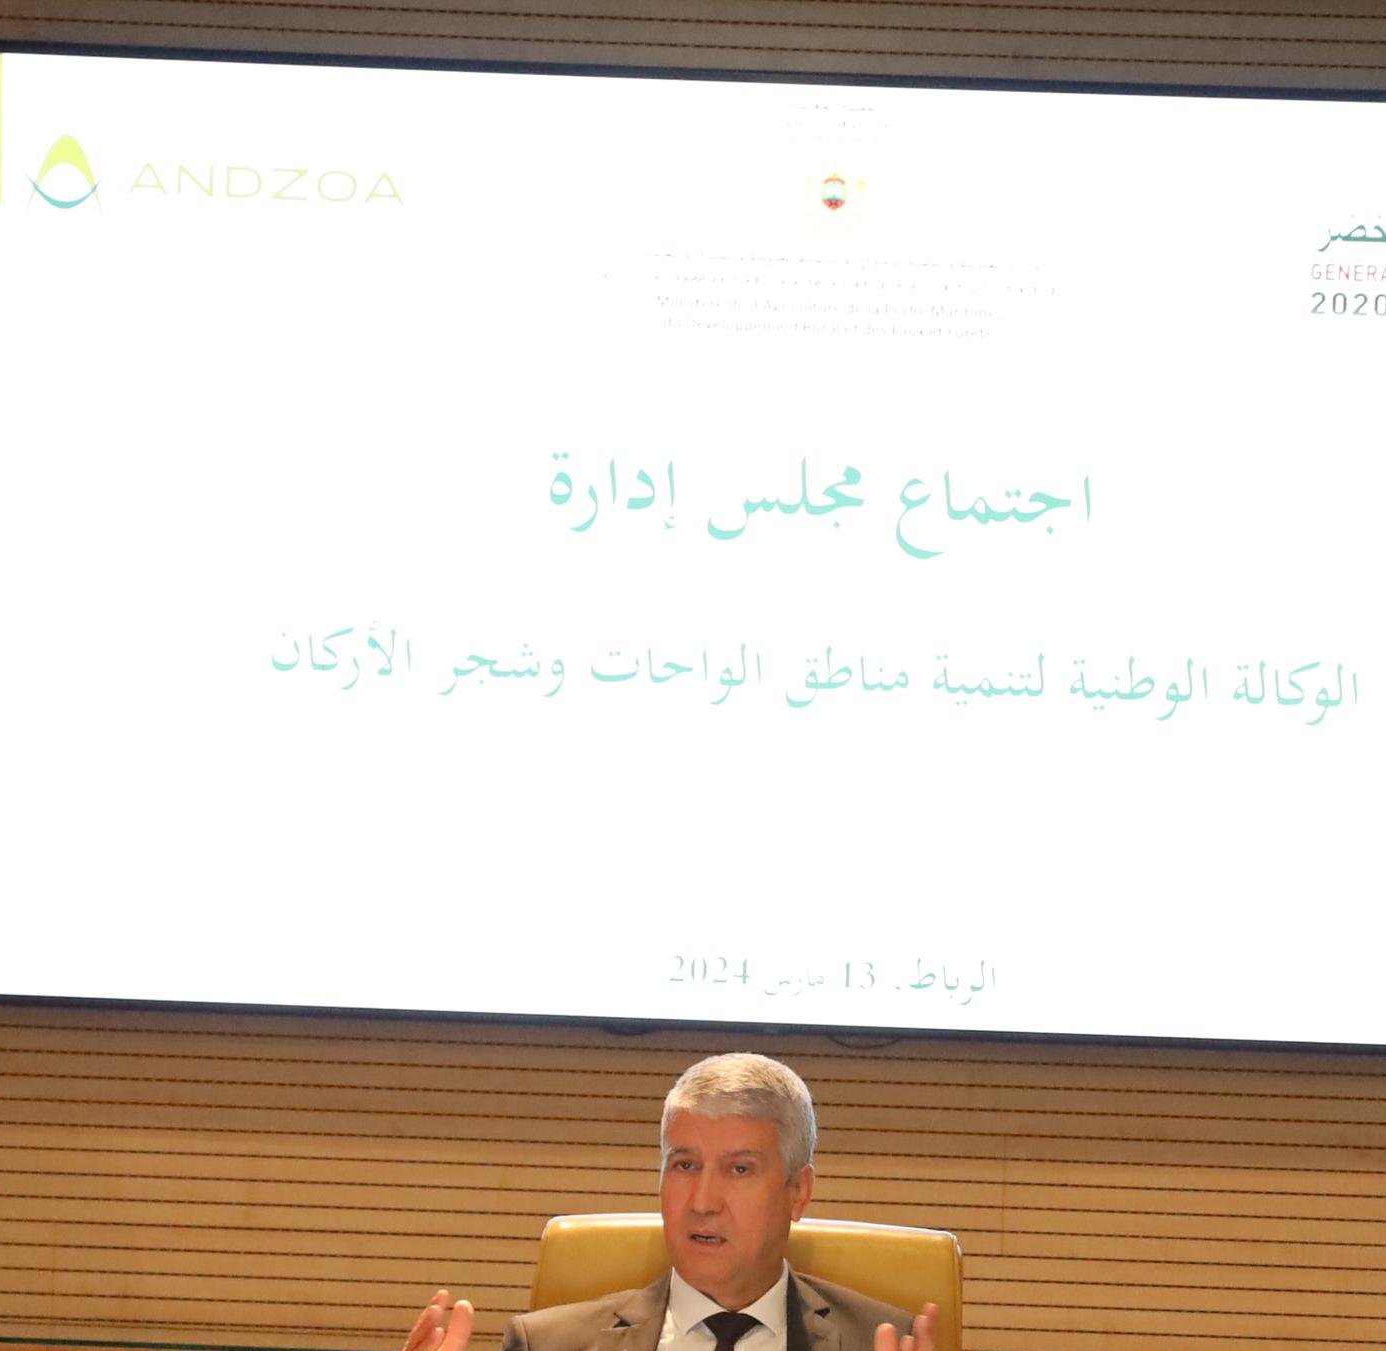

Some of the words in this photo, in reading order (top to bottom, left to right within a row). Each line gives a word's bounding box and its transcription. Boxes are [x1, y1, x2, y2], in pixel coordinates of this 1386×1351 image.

[127, 161, 406, 205] ANDZOA
[548, 450, 676, 534] إدارة
[706, 456, 865, 542] مجلس
[896, 469, 1092, 561] اجتماع
[438, 642, 567, 699] وشجر
[590, 642, 762, 706] الواحات
[785, 645, 910, 710] مناطق
[932, 652, 1046, 706] لتنمية
[1069, 655, 1209, 722] الوطنية
[1233, 659, 1360, 727] الوكالة
[668, 954, 751, 985] 2024
[844, 961, 877, 990] 13
